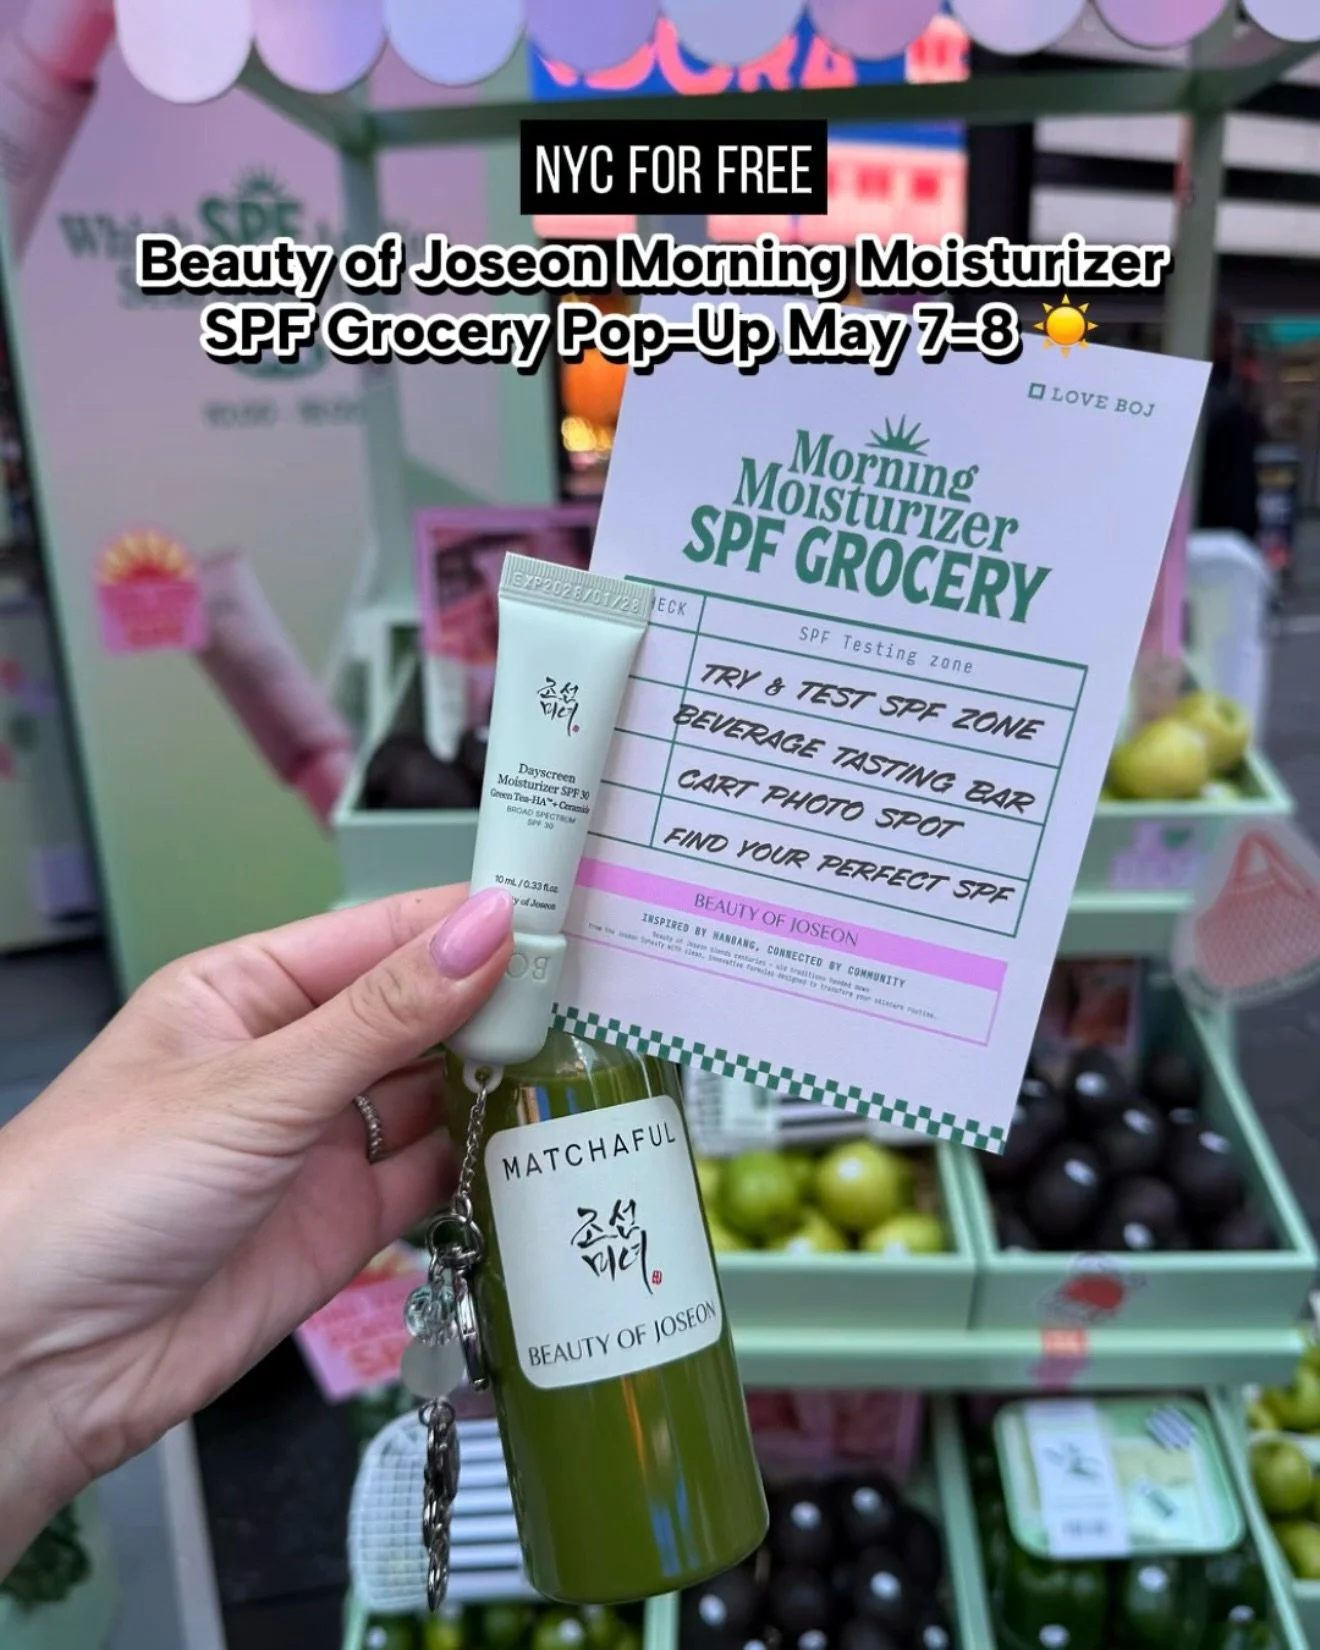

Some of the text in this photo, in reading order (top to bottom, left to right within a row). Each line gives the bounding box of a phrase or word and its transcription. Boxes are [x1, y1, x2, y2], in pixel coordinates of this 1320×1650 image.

[1051, 387, 1156, 418] LOVE BOJ
[788, 429, 979, 503] Morning
[732, 456, 1019, 552] Moisturizer
[682, 505, 1052, 623] SPF GROCERY
[799, 626, 974, 675] SPF Testing zone
[700, 663, 1045, 741] TRY & TEST SPF ZONE
[497, 773, 561, 795] Moisturizer
[560, 786, 580, 799] SPF
[518, 763, 576, 784] Dayscreen
[672, 704, 1036, 813] BEVERAGE TASTING BAR
[490, 787, 513, 800] Green
[507, 805, 576, 824] BROAD SPECTRUM
[677, 769, 964, 839] CART PHOTO SPOT
[664, 827, 1016, 907] FIND YOUR PERFECT SPF
[642, 912, 690, 933] INSPIRED
[695, 926, 707, 937] BY
[767, 945, 823, 968] CONNECTED
[828, 960, 842, 972] BY
[847, 965, 906, 988] COMMUNITY
[694, 893, 859, 947] BEAUTY OF JOSEON
[502, 1121, 676, 1181] MATCHAFUL
[570, 1199, 640, 1249] 조선
[581, 1230, 654, 1295] 미녀
[528, 1300, 717, 1367] BEAUTY OF JOSEON
